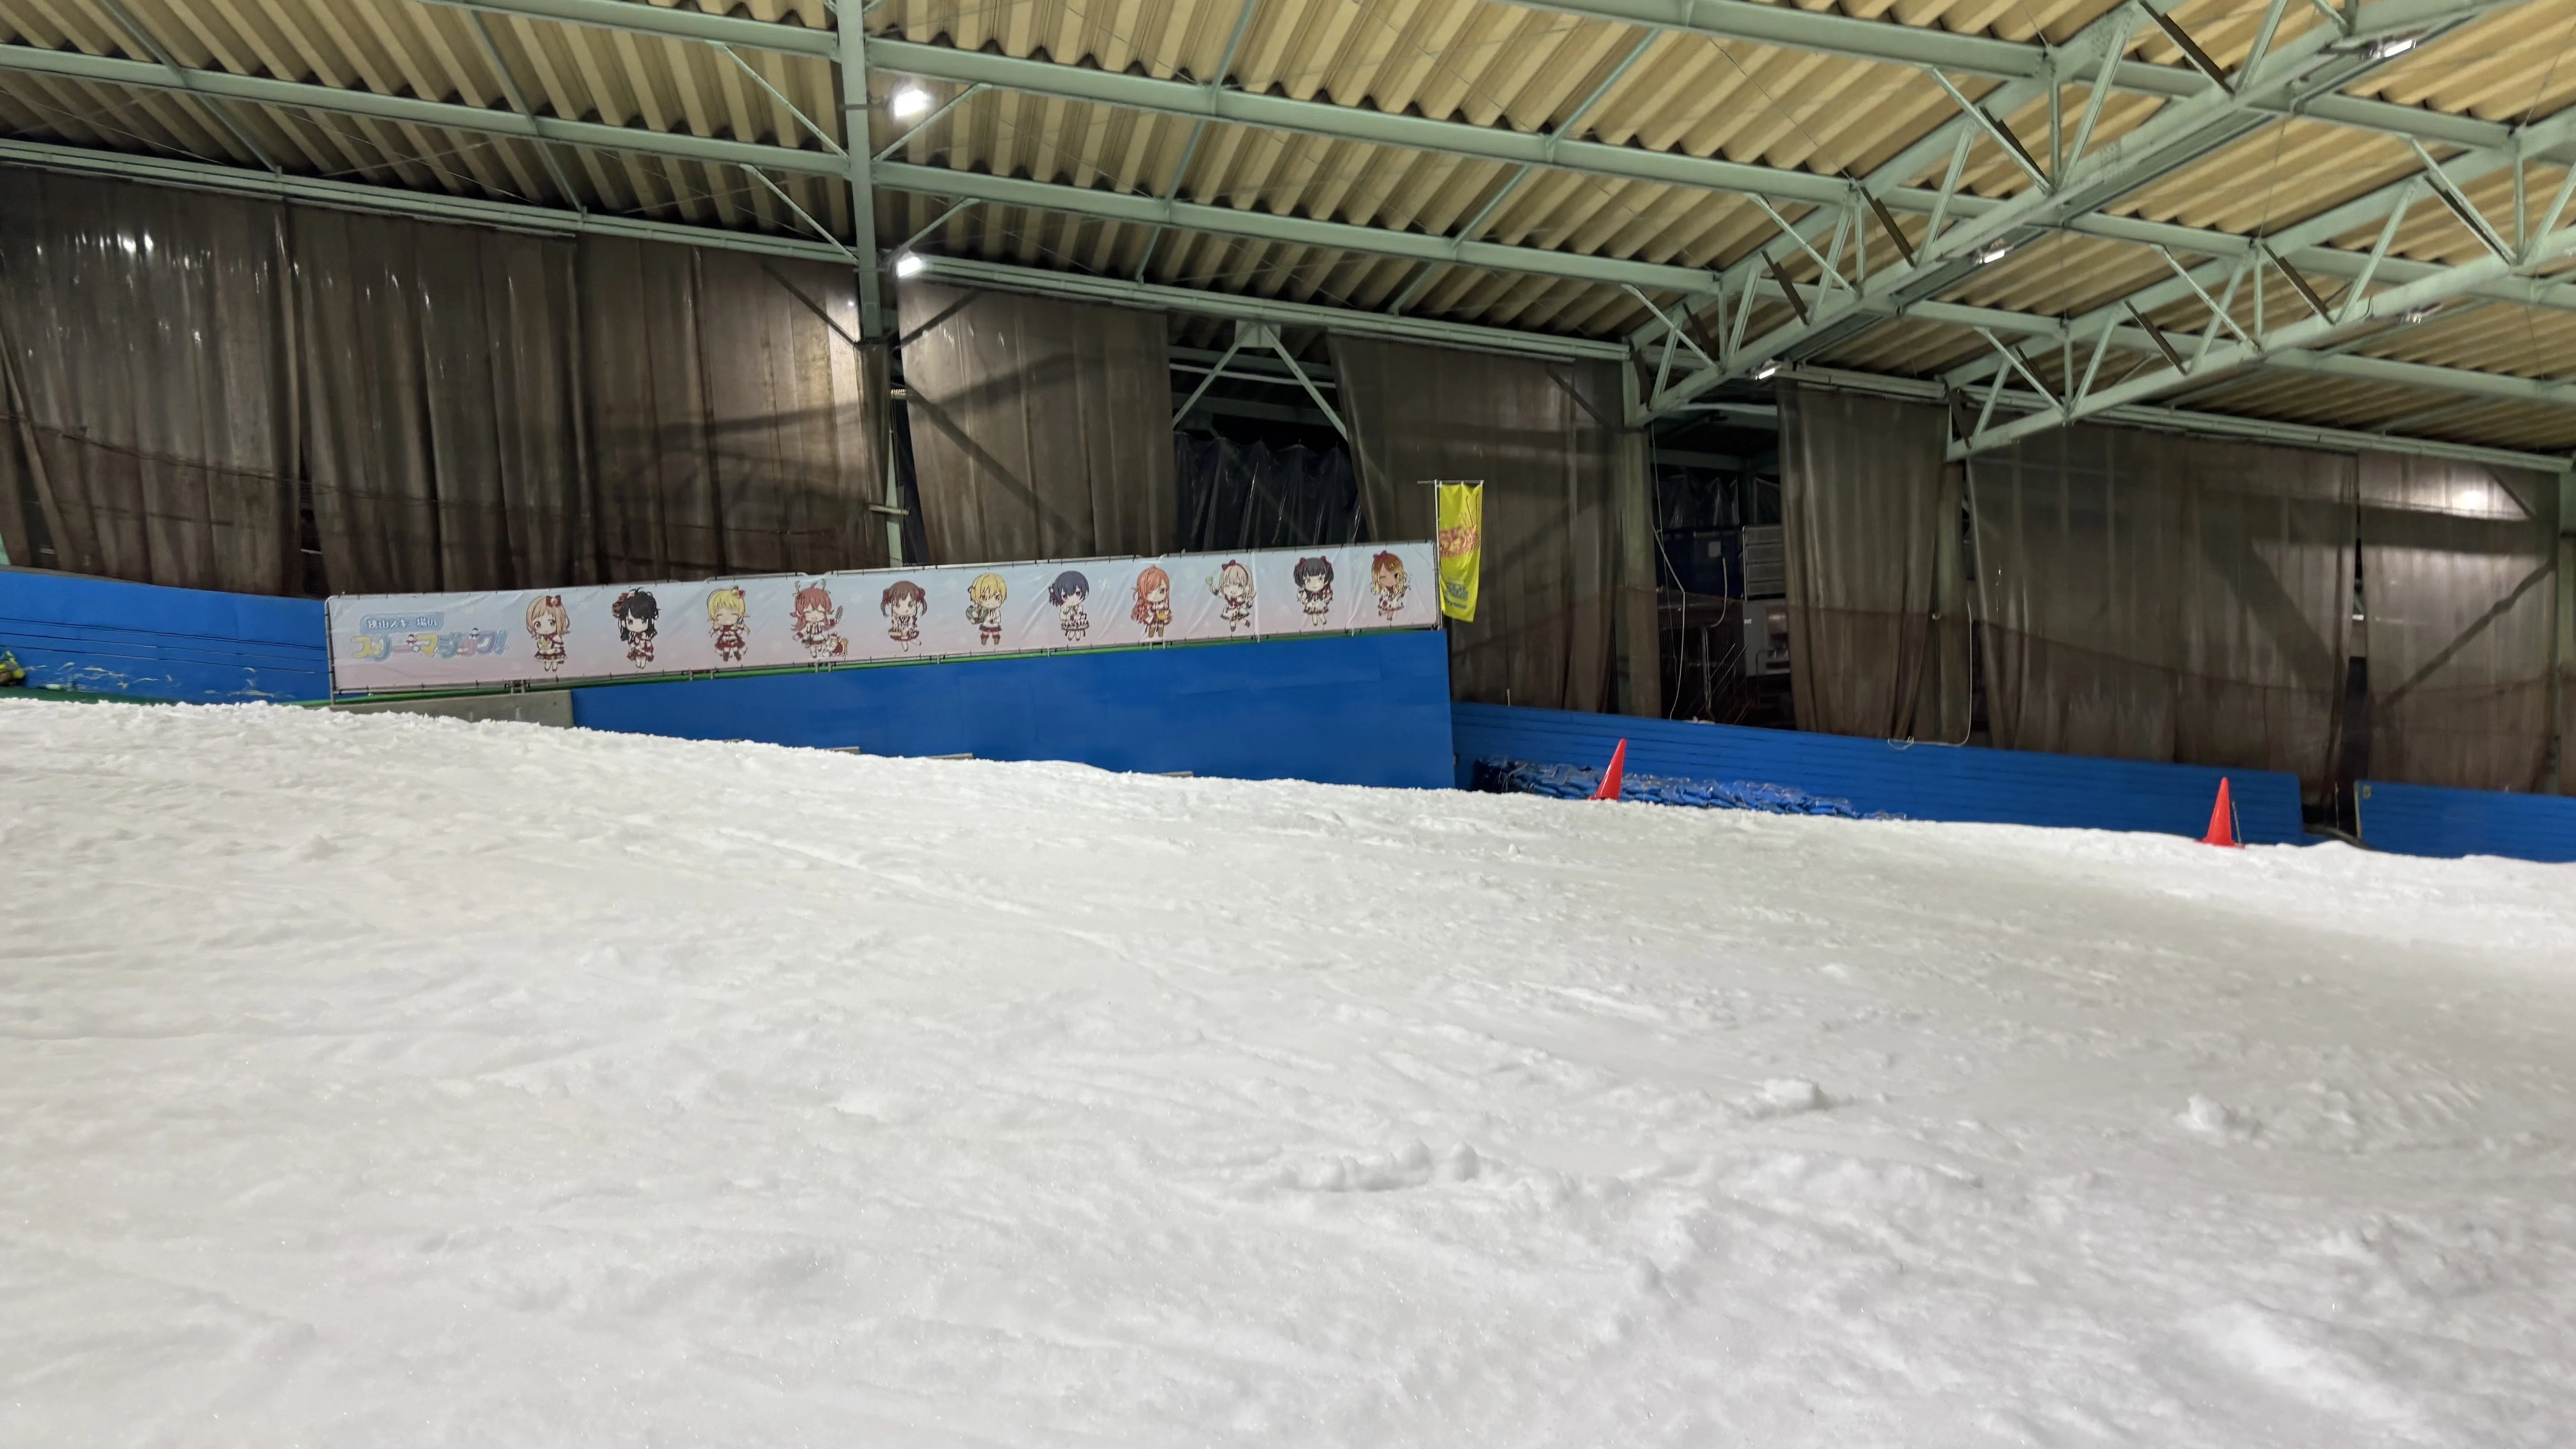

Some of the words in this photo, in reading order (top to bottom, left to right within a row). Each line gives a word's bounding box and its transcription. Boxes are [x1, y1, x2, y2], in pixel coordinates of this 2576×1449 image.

[368, 616, 437, 629] 狭山スキ場の
